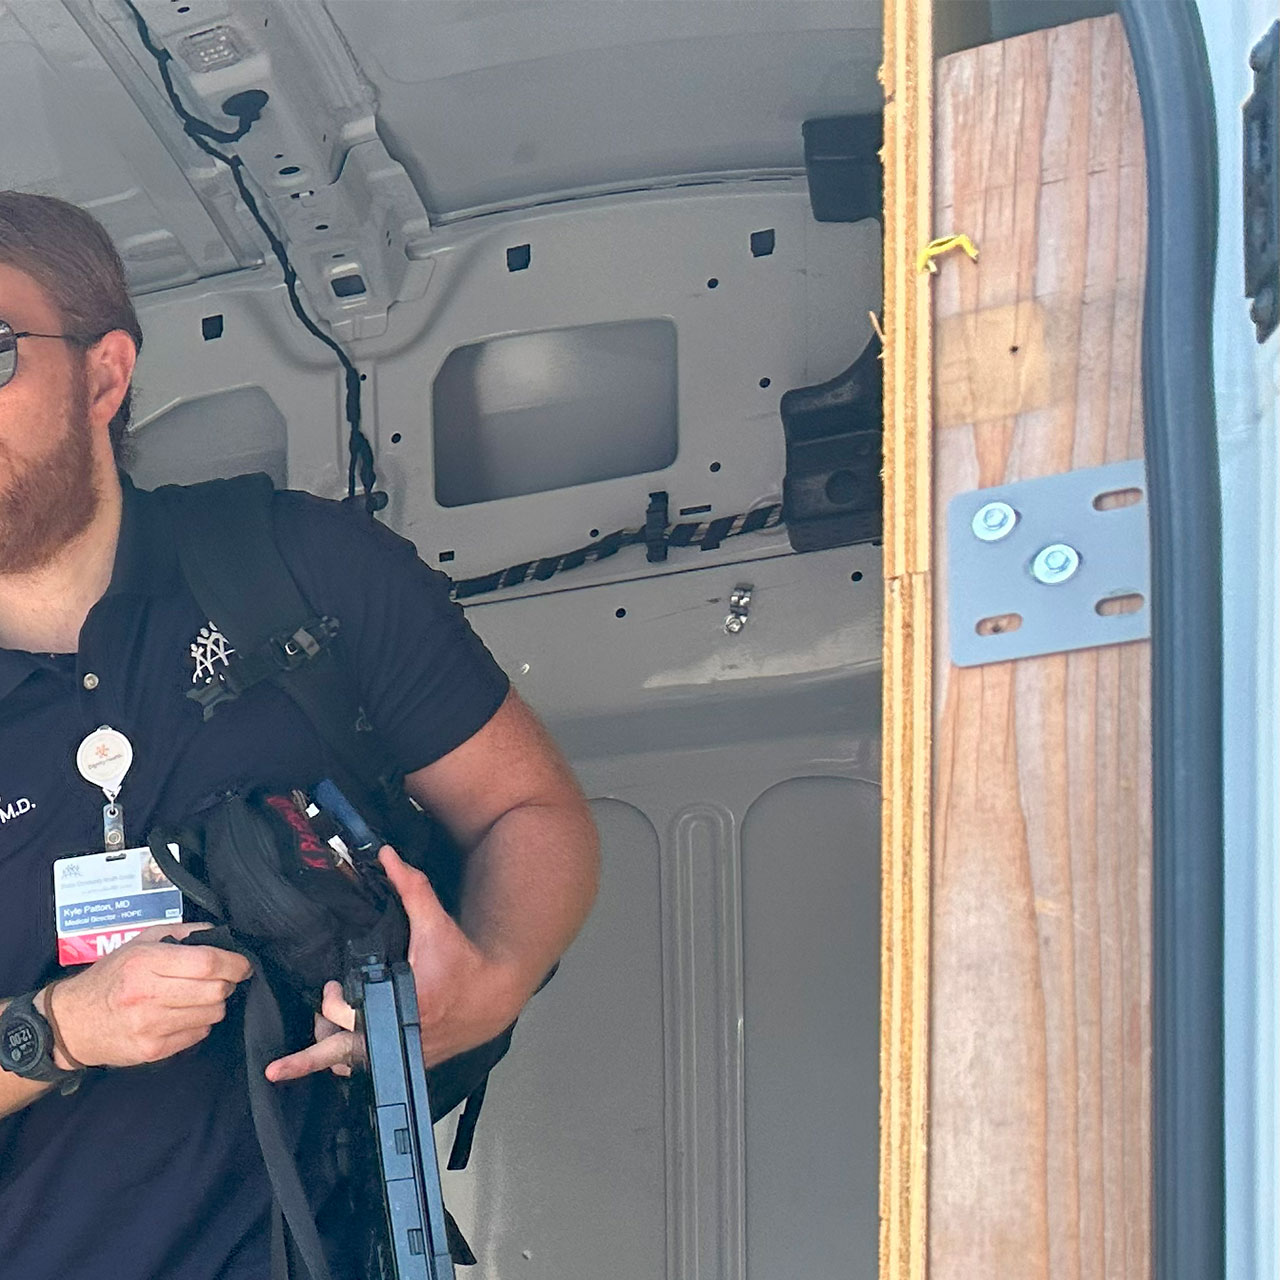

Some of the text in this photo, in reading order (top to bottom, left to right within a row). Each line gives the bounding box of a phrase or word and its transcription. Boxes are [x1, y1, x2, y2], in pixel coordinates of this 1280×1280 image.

[63, 907, 82, 918] Kyle
[115, 900, 130, 910] MD
[64, 917, 90, 927] Medical
[90, 913, 116, 923] Director
[120, 909, 143, 919] HOPE
